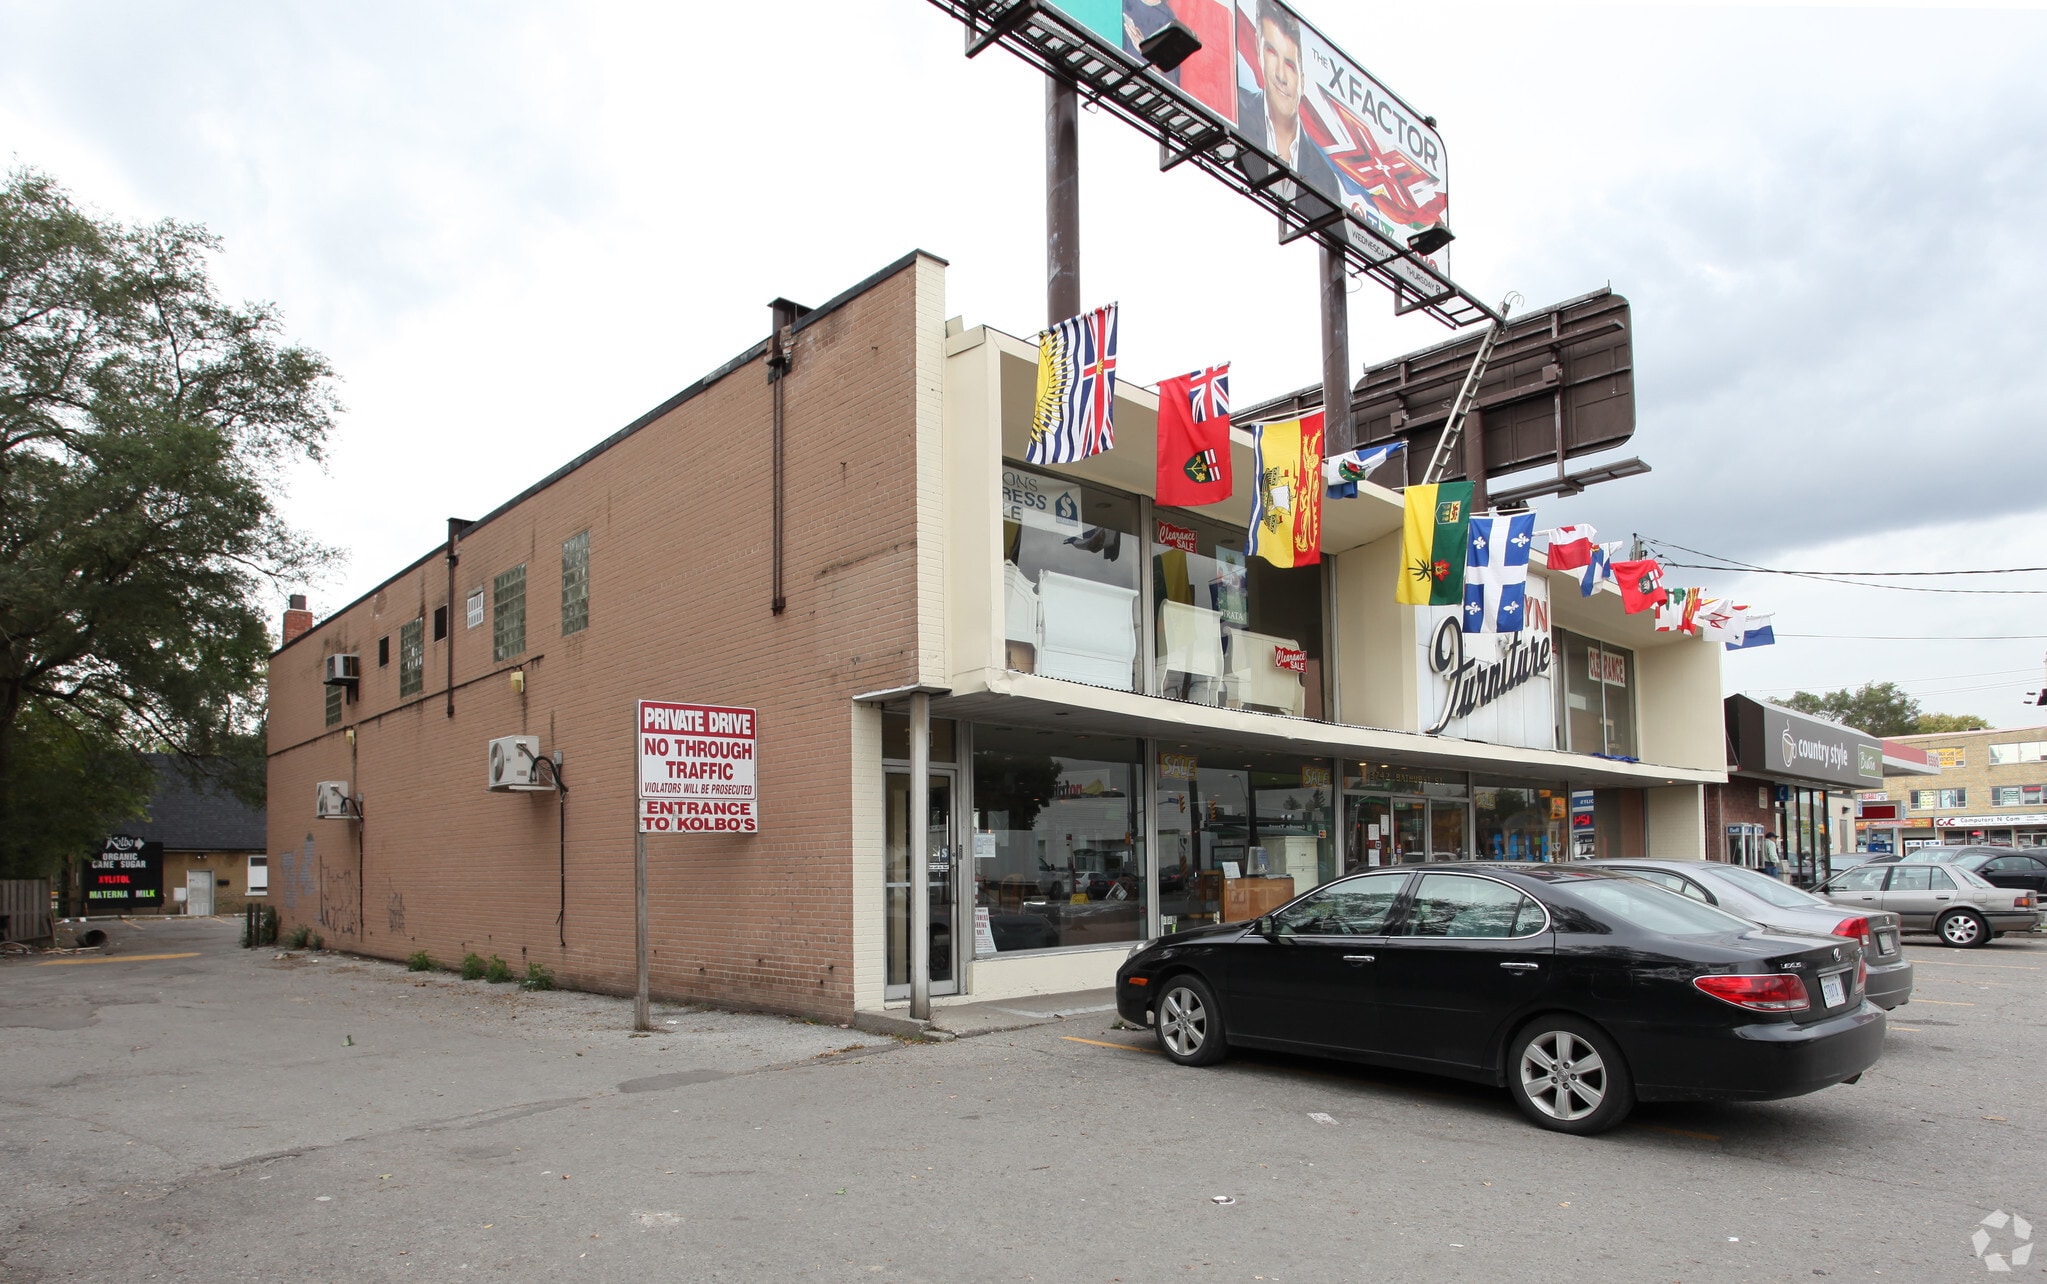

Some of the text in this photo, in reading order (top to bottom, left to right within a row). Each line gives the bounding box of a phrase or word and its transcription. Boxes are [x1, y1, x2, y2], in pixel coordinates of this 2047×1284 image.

[1312, 48, 1438, 173] THE X FACTOR
[1352, 228, 1389, 259] WEDNESDAY
[1406, 266, 1440, 294] THURSDAY 8
[1160, 526, 1195, 544] Clearance
[1176, 540, 1194, 552] SALE
[1276, 650, 1305, 666] Clearance
[1290, 661, 1304, 670] SALE
[1426, 616, 1550, 734] Furniture
[1590, 651, 1625, 684] CLERANCE
[644, 707, 752, 735] PRIVATE DRIVE
[644, 738, 752, 760] NO THROUGH
[1798, 739, 1848, 770] country style
[666, 761, 733, 780] TRAFFIC
[1165, 755, 1195, 777] SALE
[1304, 768, 1328, 786] SALE
[1396, 773, 1431, 784] BATHURST
[645, 782, 752, 795] VIOLATORS WILL BE PROSECUTED
[647, 801, 751, 816] ENTRANCE
[642, 817, 756, 831] TO KOLBO'S
[106, 836, 134, 850] Kolbo
[98, 875, 130, 883] XYLITOL
[90, 890, 128, 899] MATERNA
